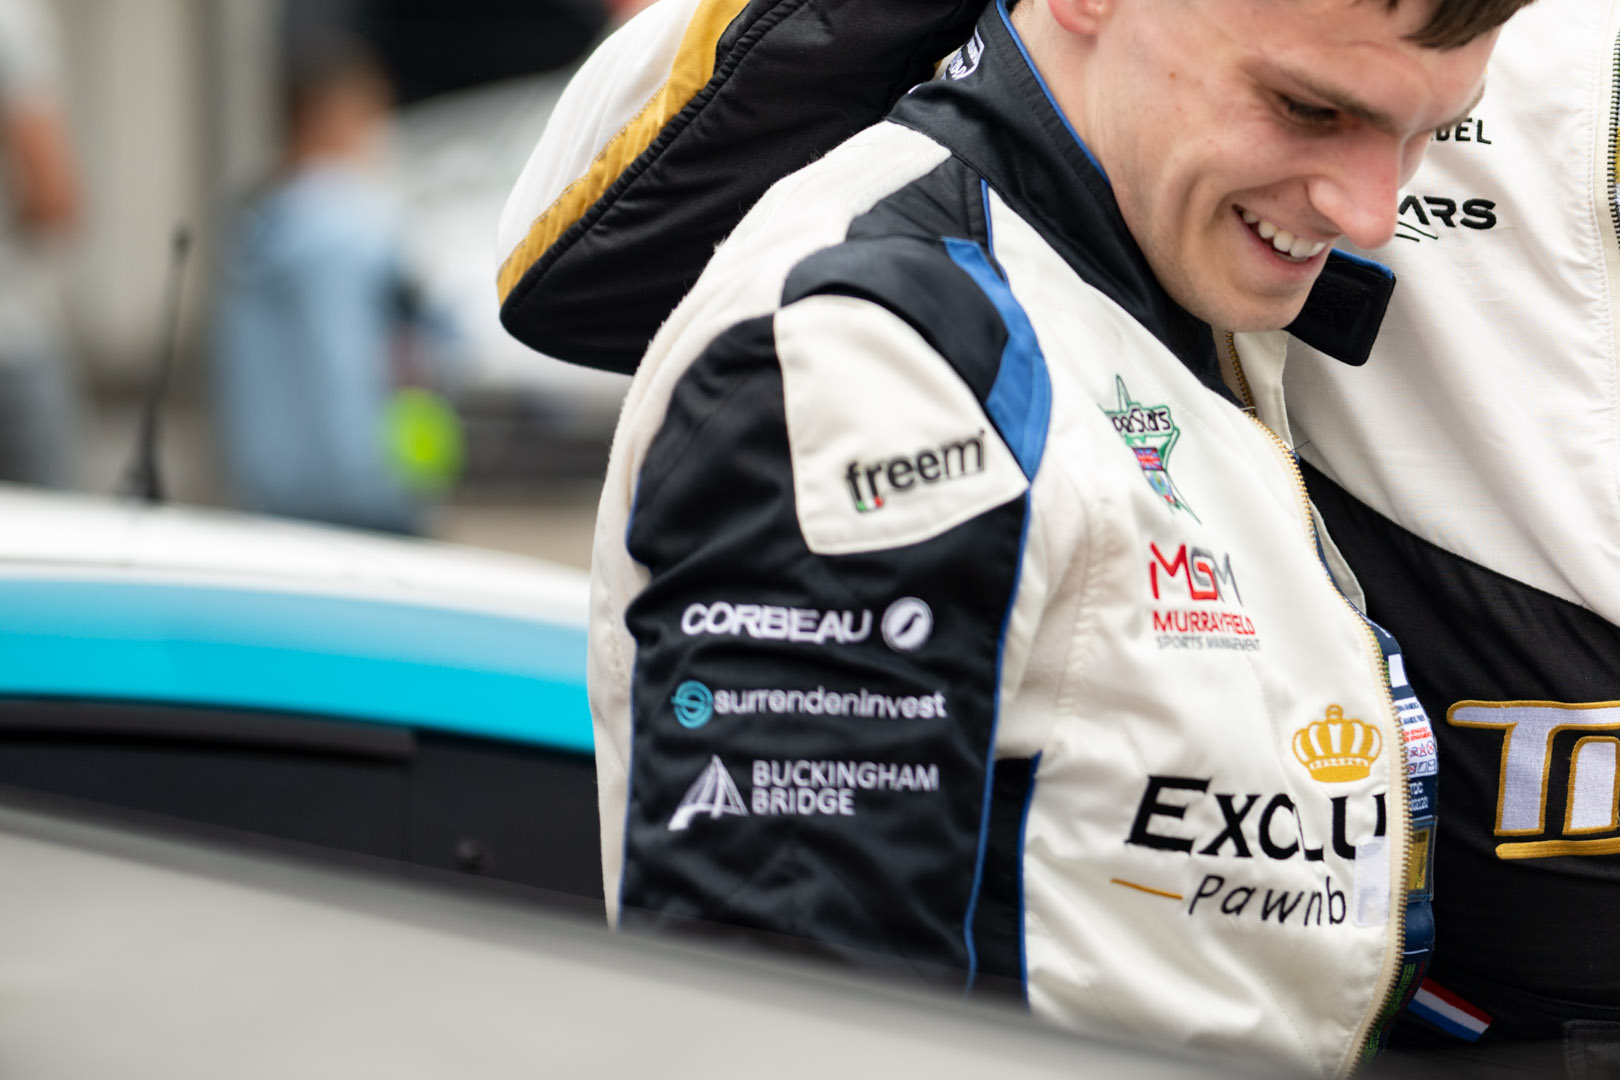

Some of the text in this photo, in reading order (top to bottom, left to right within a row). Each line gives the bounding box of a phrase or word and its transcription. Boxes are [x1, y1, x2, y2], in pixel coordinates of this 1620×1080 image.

[844, 433, 985, 512] freem
[681, 601, 873, 645] CORBEAU
[1156, 635, 1203, 649] SPORTS
[713, 685, 947, 718] surrendeninvest
[752, 760, 939, 791] BUCKINGHAM
[751, 787, 855, 816] BRIDGE
[1189, 875, 1347, 926] Pawnb
